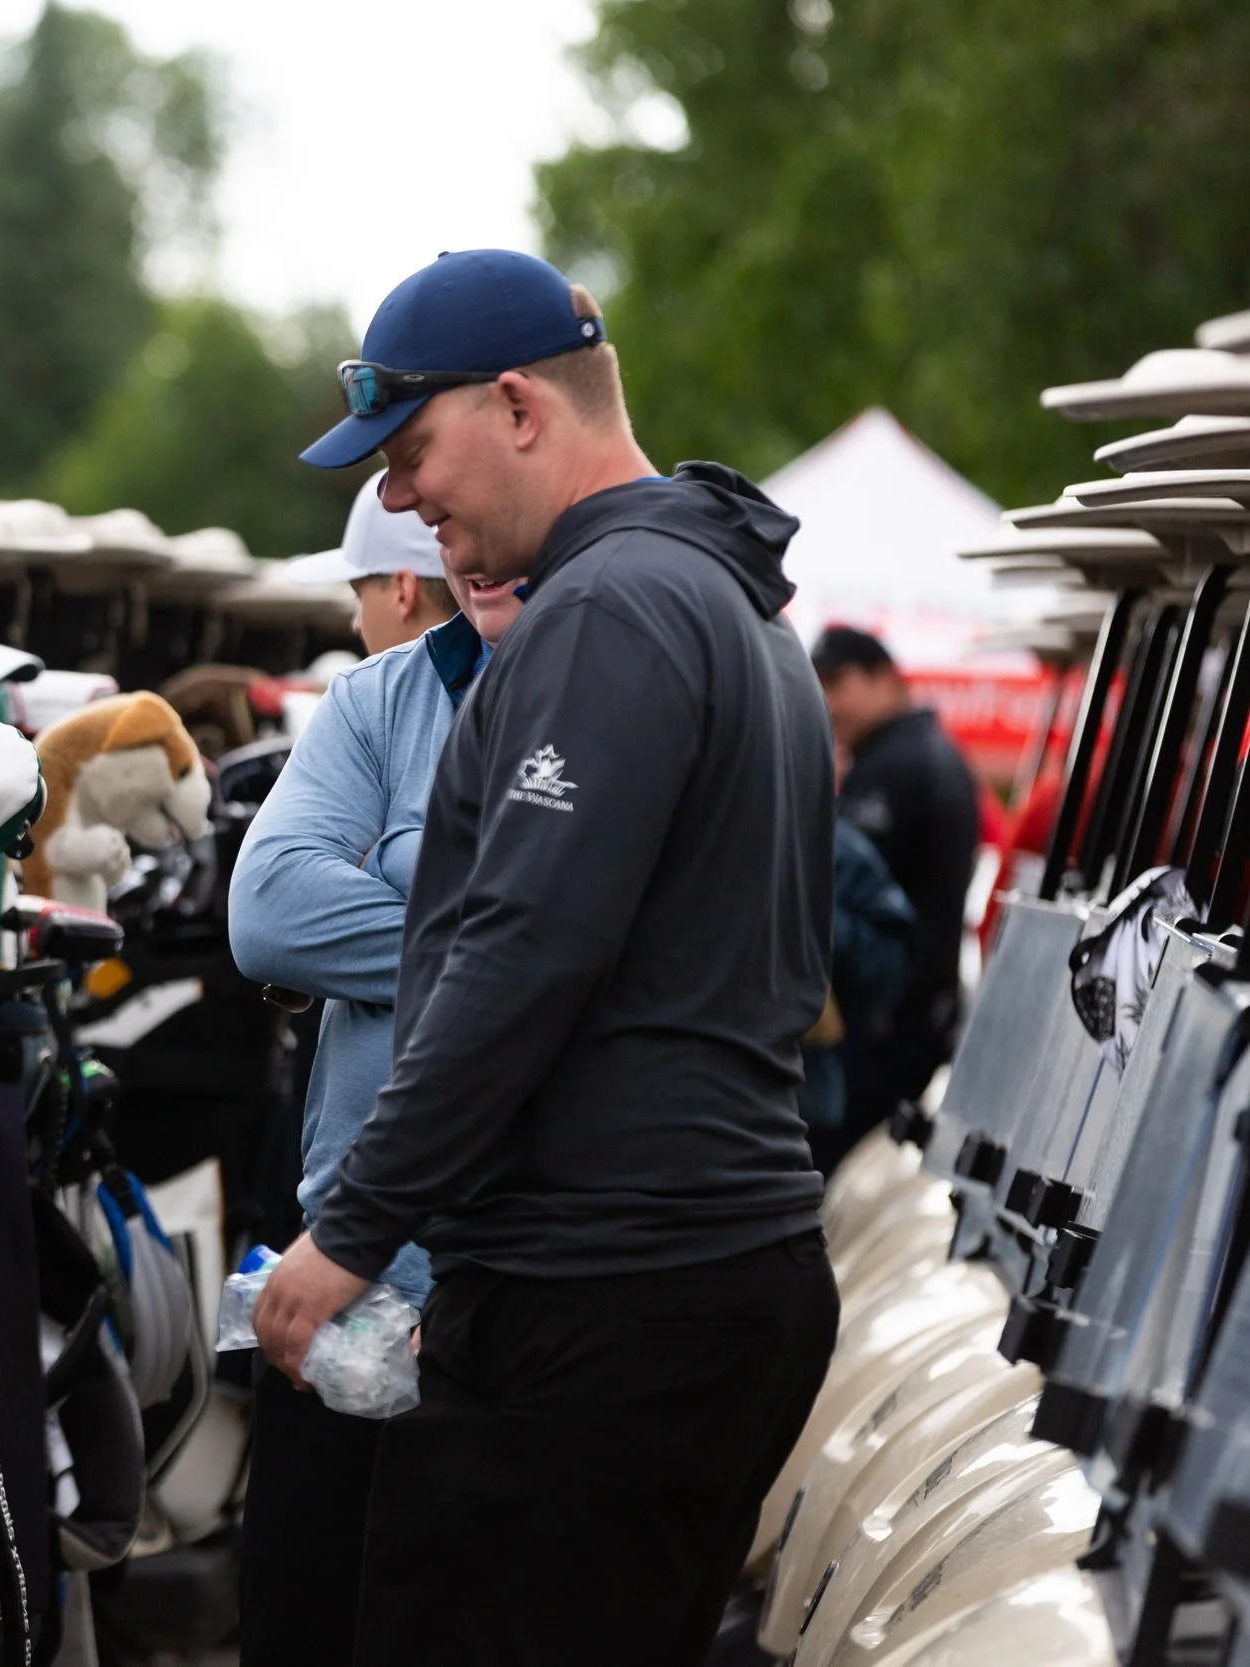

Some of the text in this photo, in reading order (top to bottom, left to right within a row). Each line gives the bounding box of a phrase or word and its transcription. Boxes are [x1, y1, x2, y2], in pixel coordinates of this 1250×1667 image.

[508, 789, 574, 811] THE WASCANA
[11, 1544, 30, 1632] XTREME
